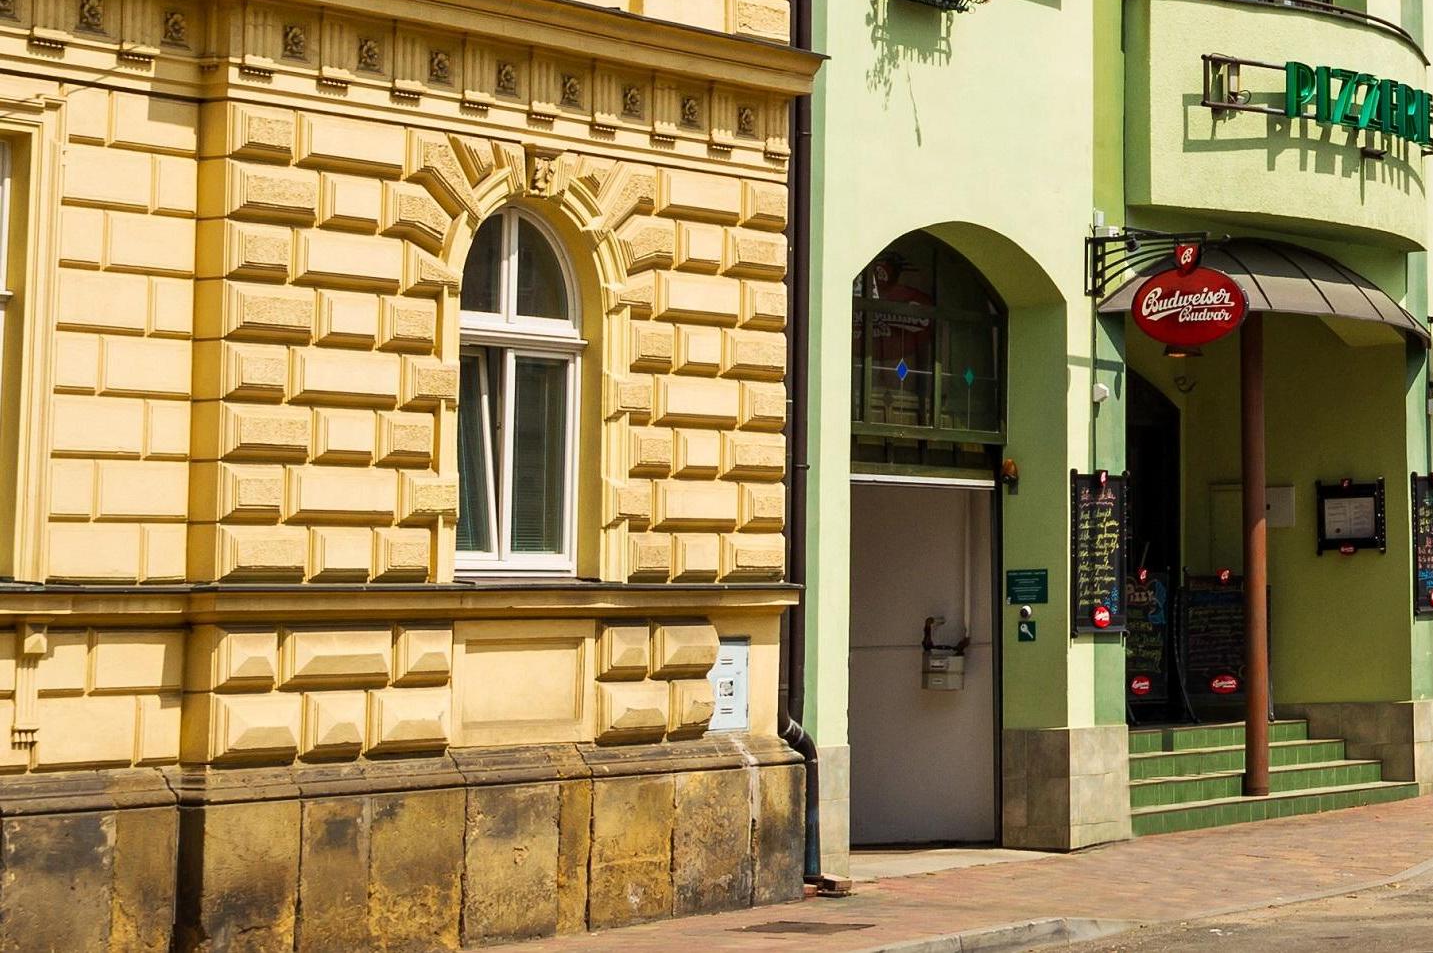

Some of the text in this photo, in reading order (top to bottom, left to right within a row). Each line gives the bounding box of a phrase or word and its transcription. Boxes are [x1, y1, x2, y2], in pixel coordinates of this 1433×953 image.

[1285, 61, 1433, 147] PIZZERIE
[1141, 287, 1235, 317] Budweiser
[1179, 306, 1231, 322] Budvar
